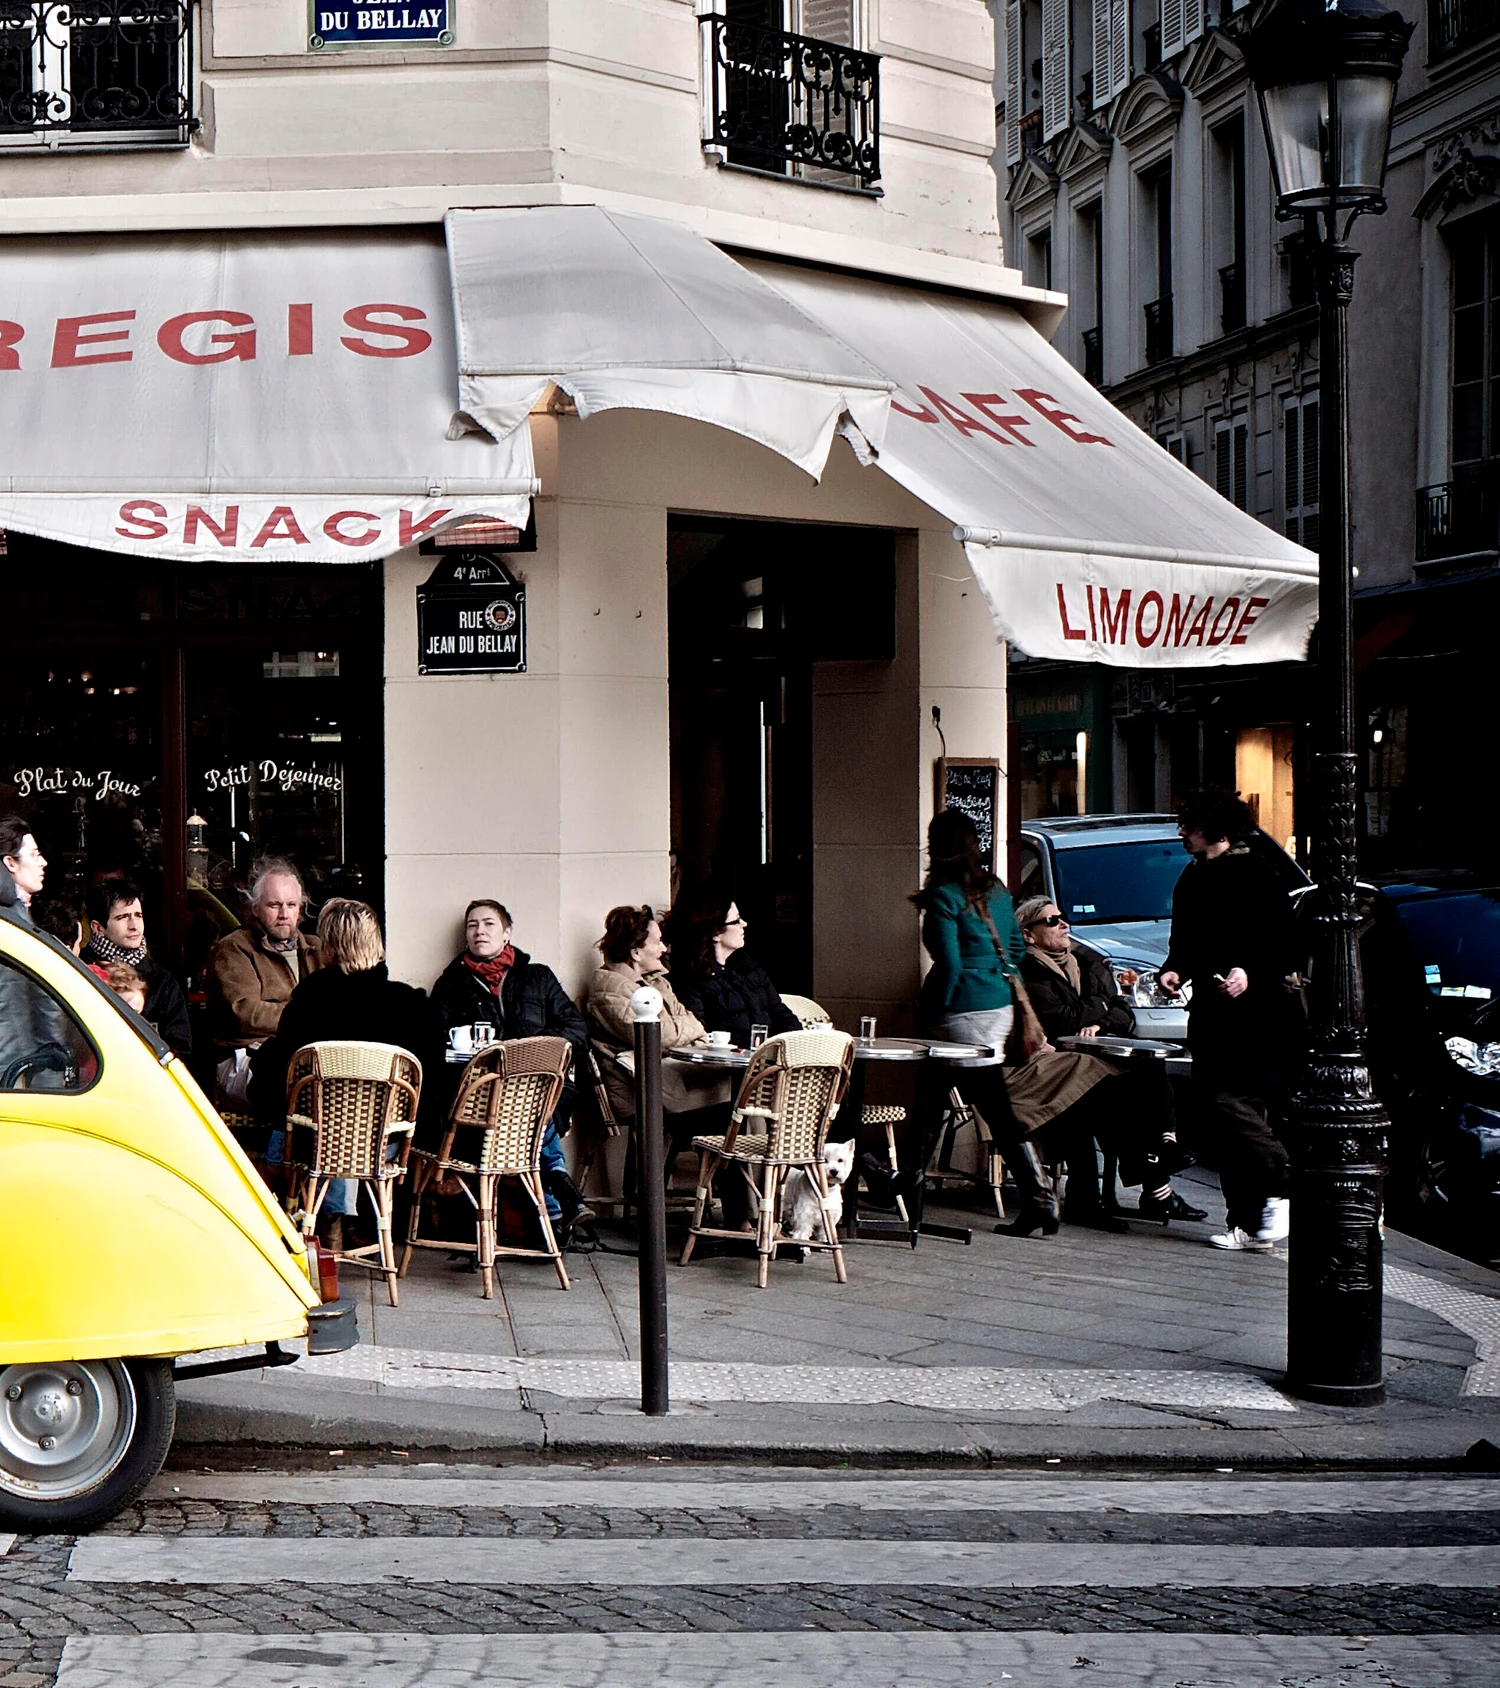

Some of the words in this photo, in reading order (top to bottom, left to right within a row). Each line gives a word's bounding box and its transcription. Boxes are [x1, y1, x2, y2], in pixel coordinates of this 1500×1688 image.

[320, 10, 349, 31] DU
[356, 8, 444, 30] BELLAY
[115, 499, 453, 548] SNACK
[459, 611, 484, 629] RUE
[1056, 582, 1271, 649] LIMONADE
[426, 636, 455, 654] JEAN
[459, 635, 474, 654] DU
[477, 634, 518, 653] BELLAY
[13, 766, 68, 798] Plat
[71, 770, 95, 788] du
[95, 770, 142, 801] Jour
[204, 764, 252, 792] Petit
